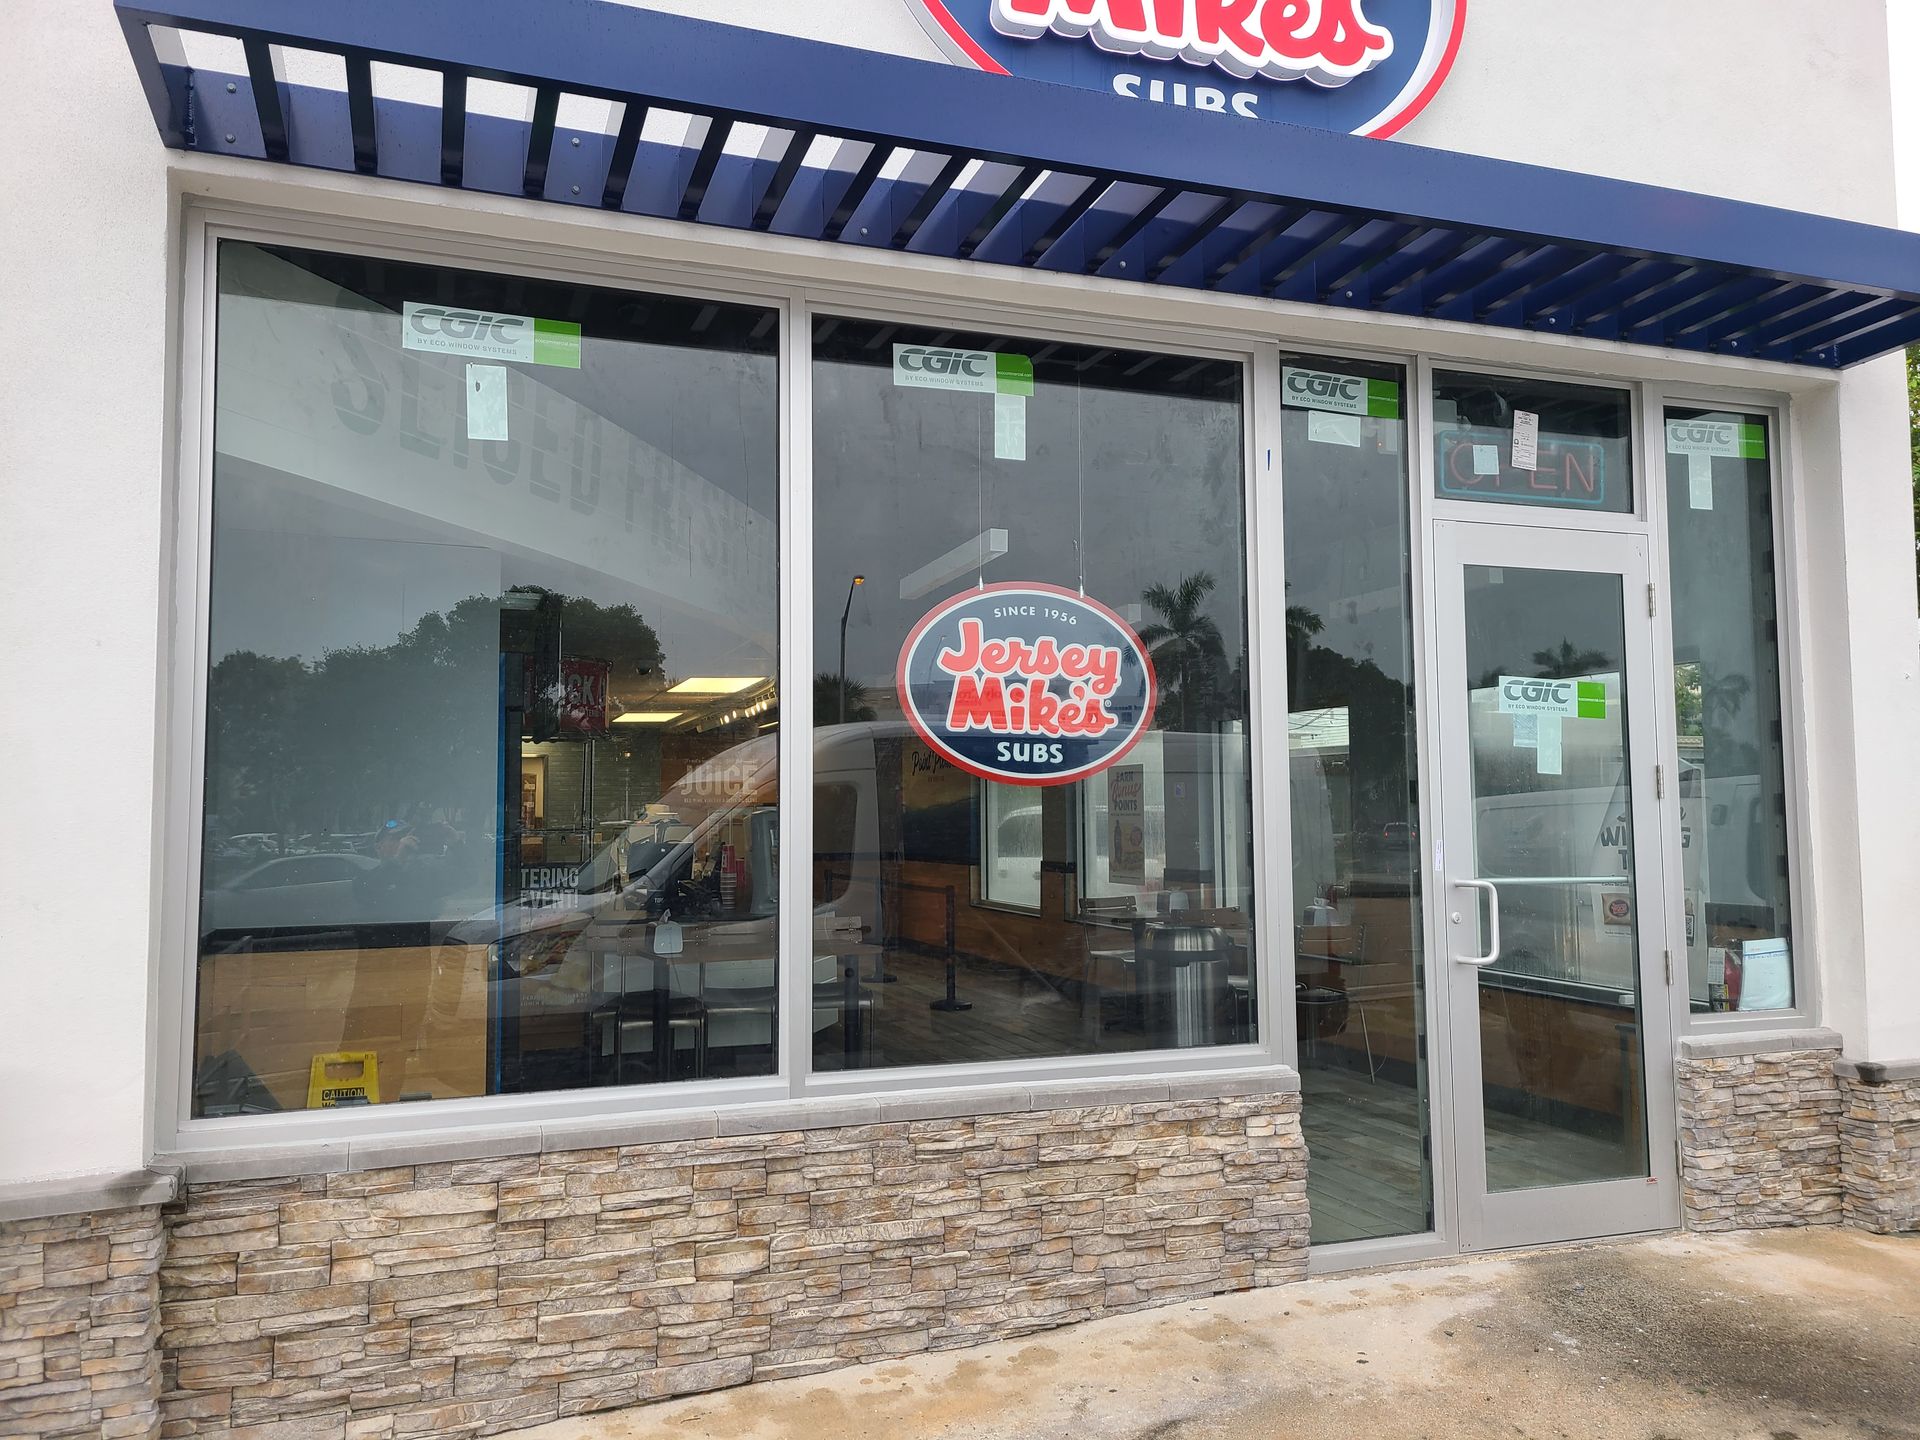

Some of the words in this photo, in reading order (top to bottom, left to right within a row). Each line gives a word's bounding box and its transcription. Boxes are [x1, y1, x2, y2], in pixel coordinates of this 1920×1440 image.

[448, 342, 480, 350] WINDOW
[482, 345, 517, 355] SYSTEMS
[956, 379, 984, 387] SYSTEMS
[1334, 400, 1357, 409] SYSTEMS
[1451, 443, 1595, 492] OEN
[993, 606, 1036, 618] SINCE
[1044, 608, 1078, 625] 1956
[938, 619, 1119, 696] Jersey
[948, 674, 1116, 736] Mike's
[997, 742, 1064, 764] SUBS
[681, 764, 758, 796] JUICE
[521, 868, 579, 888] TERING
[323, 1088, 364, 1100] CAUTION
